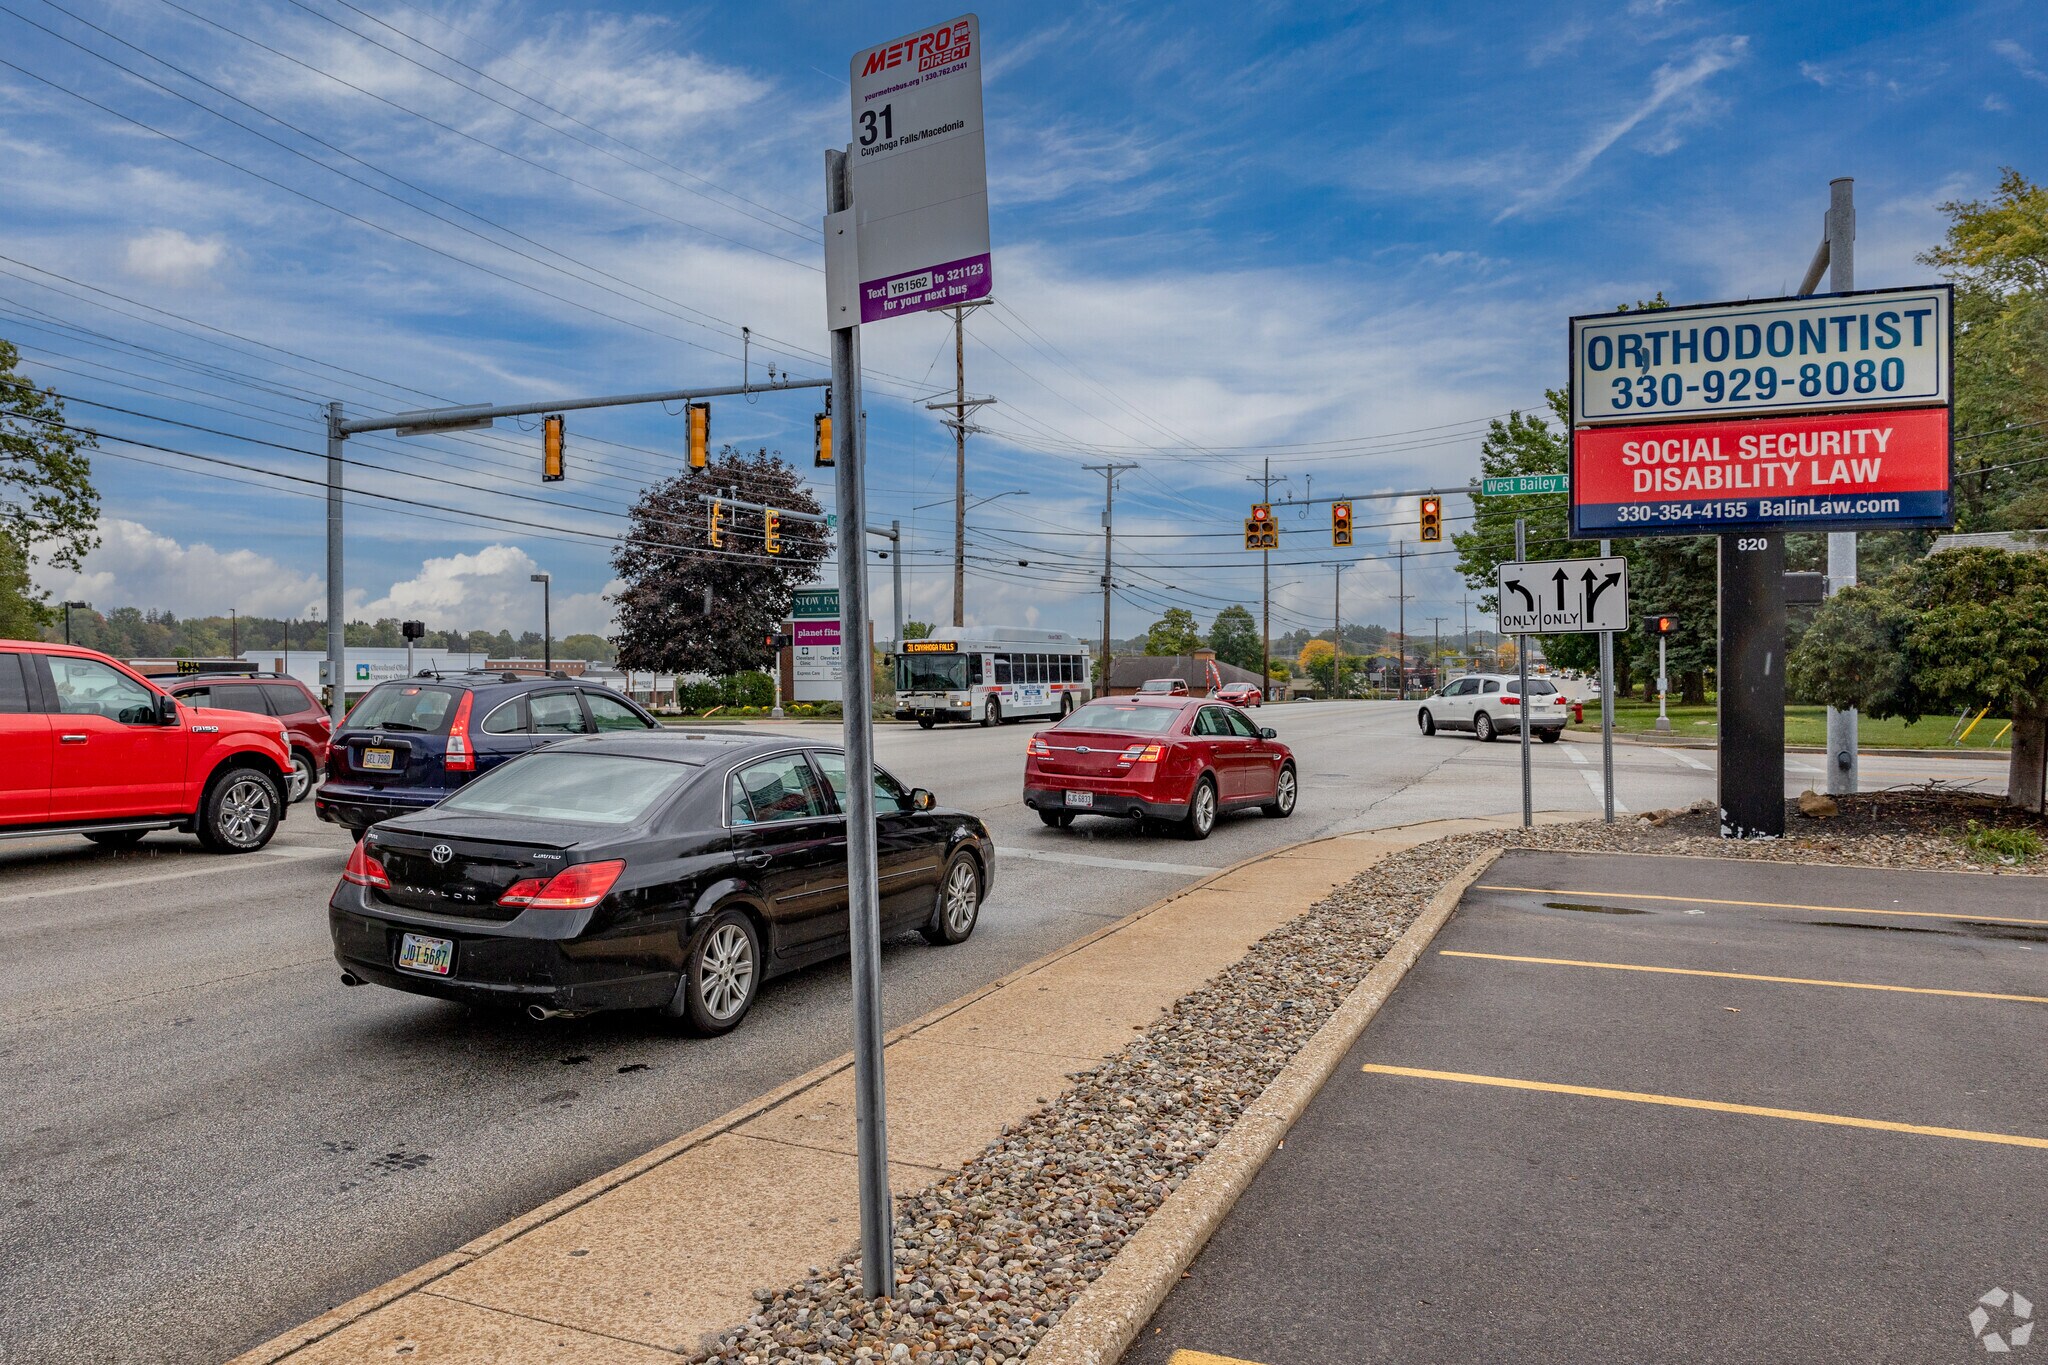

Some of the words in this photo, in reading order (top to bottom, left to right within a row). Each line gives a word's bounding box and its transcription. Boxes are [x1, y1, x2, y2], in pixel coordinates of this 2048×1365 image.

[861, 27, 951, 77] METRO
[920, 44, 969, 71] DIRECT
[864, 78, 920, 102] yourmetrobus.org
[859, 104, 893, 146] 31
[861, 140, 898, 157] Cuyahoga
[900, 120, 964, 146] Falls/Macedonia
[867, 286, 886, 300] Text
[891, 277, 928, 294] YB1562
[934, 273, 945, 284] to
[947, 263, 984, 281] 321123
[883, 300, 898, 311] for
[900, 295, 922, 310] your
[924, 288, 947, 302] next
[948, 284, 968, 297] bus
[1587, 308, 1932, 372] ORTHODONTIST
[1611, 357, 1906, 410] 330-929-8080
[1622, 438, 1729, 466] SOCIAL
[1738, 428, 1893, 461] SECURITY
[1487, 479, 1514, 492] West
[1520, 477, 1556, 492] Bailey
[1633, 462, 1800, 493] DISABILITY
[1811, 458, 1881, 486] LAW
[1617, 502, 1748, 522] 330-354-4155
[1759, 498, 1900, 517] BalinLaw.com
[1738, 538, 1768, 551] 820
[795, 597, 819, 606] STOW
[1503, 614, 1538, 626] ONLY
[1543, 613, 1579, 625] ONLY
[797, 628, 823, 638] planet
[907, 644, 914, 652] 31
[939, 643, 954, 651] FALLS
[404, 886, 476, 901] AVALON
[403, 944, 422, 962] JDT
[423, 947, 447, 966] 5687
